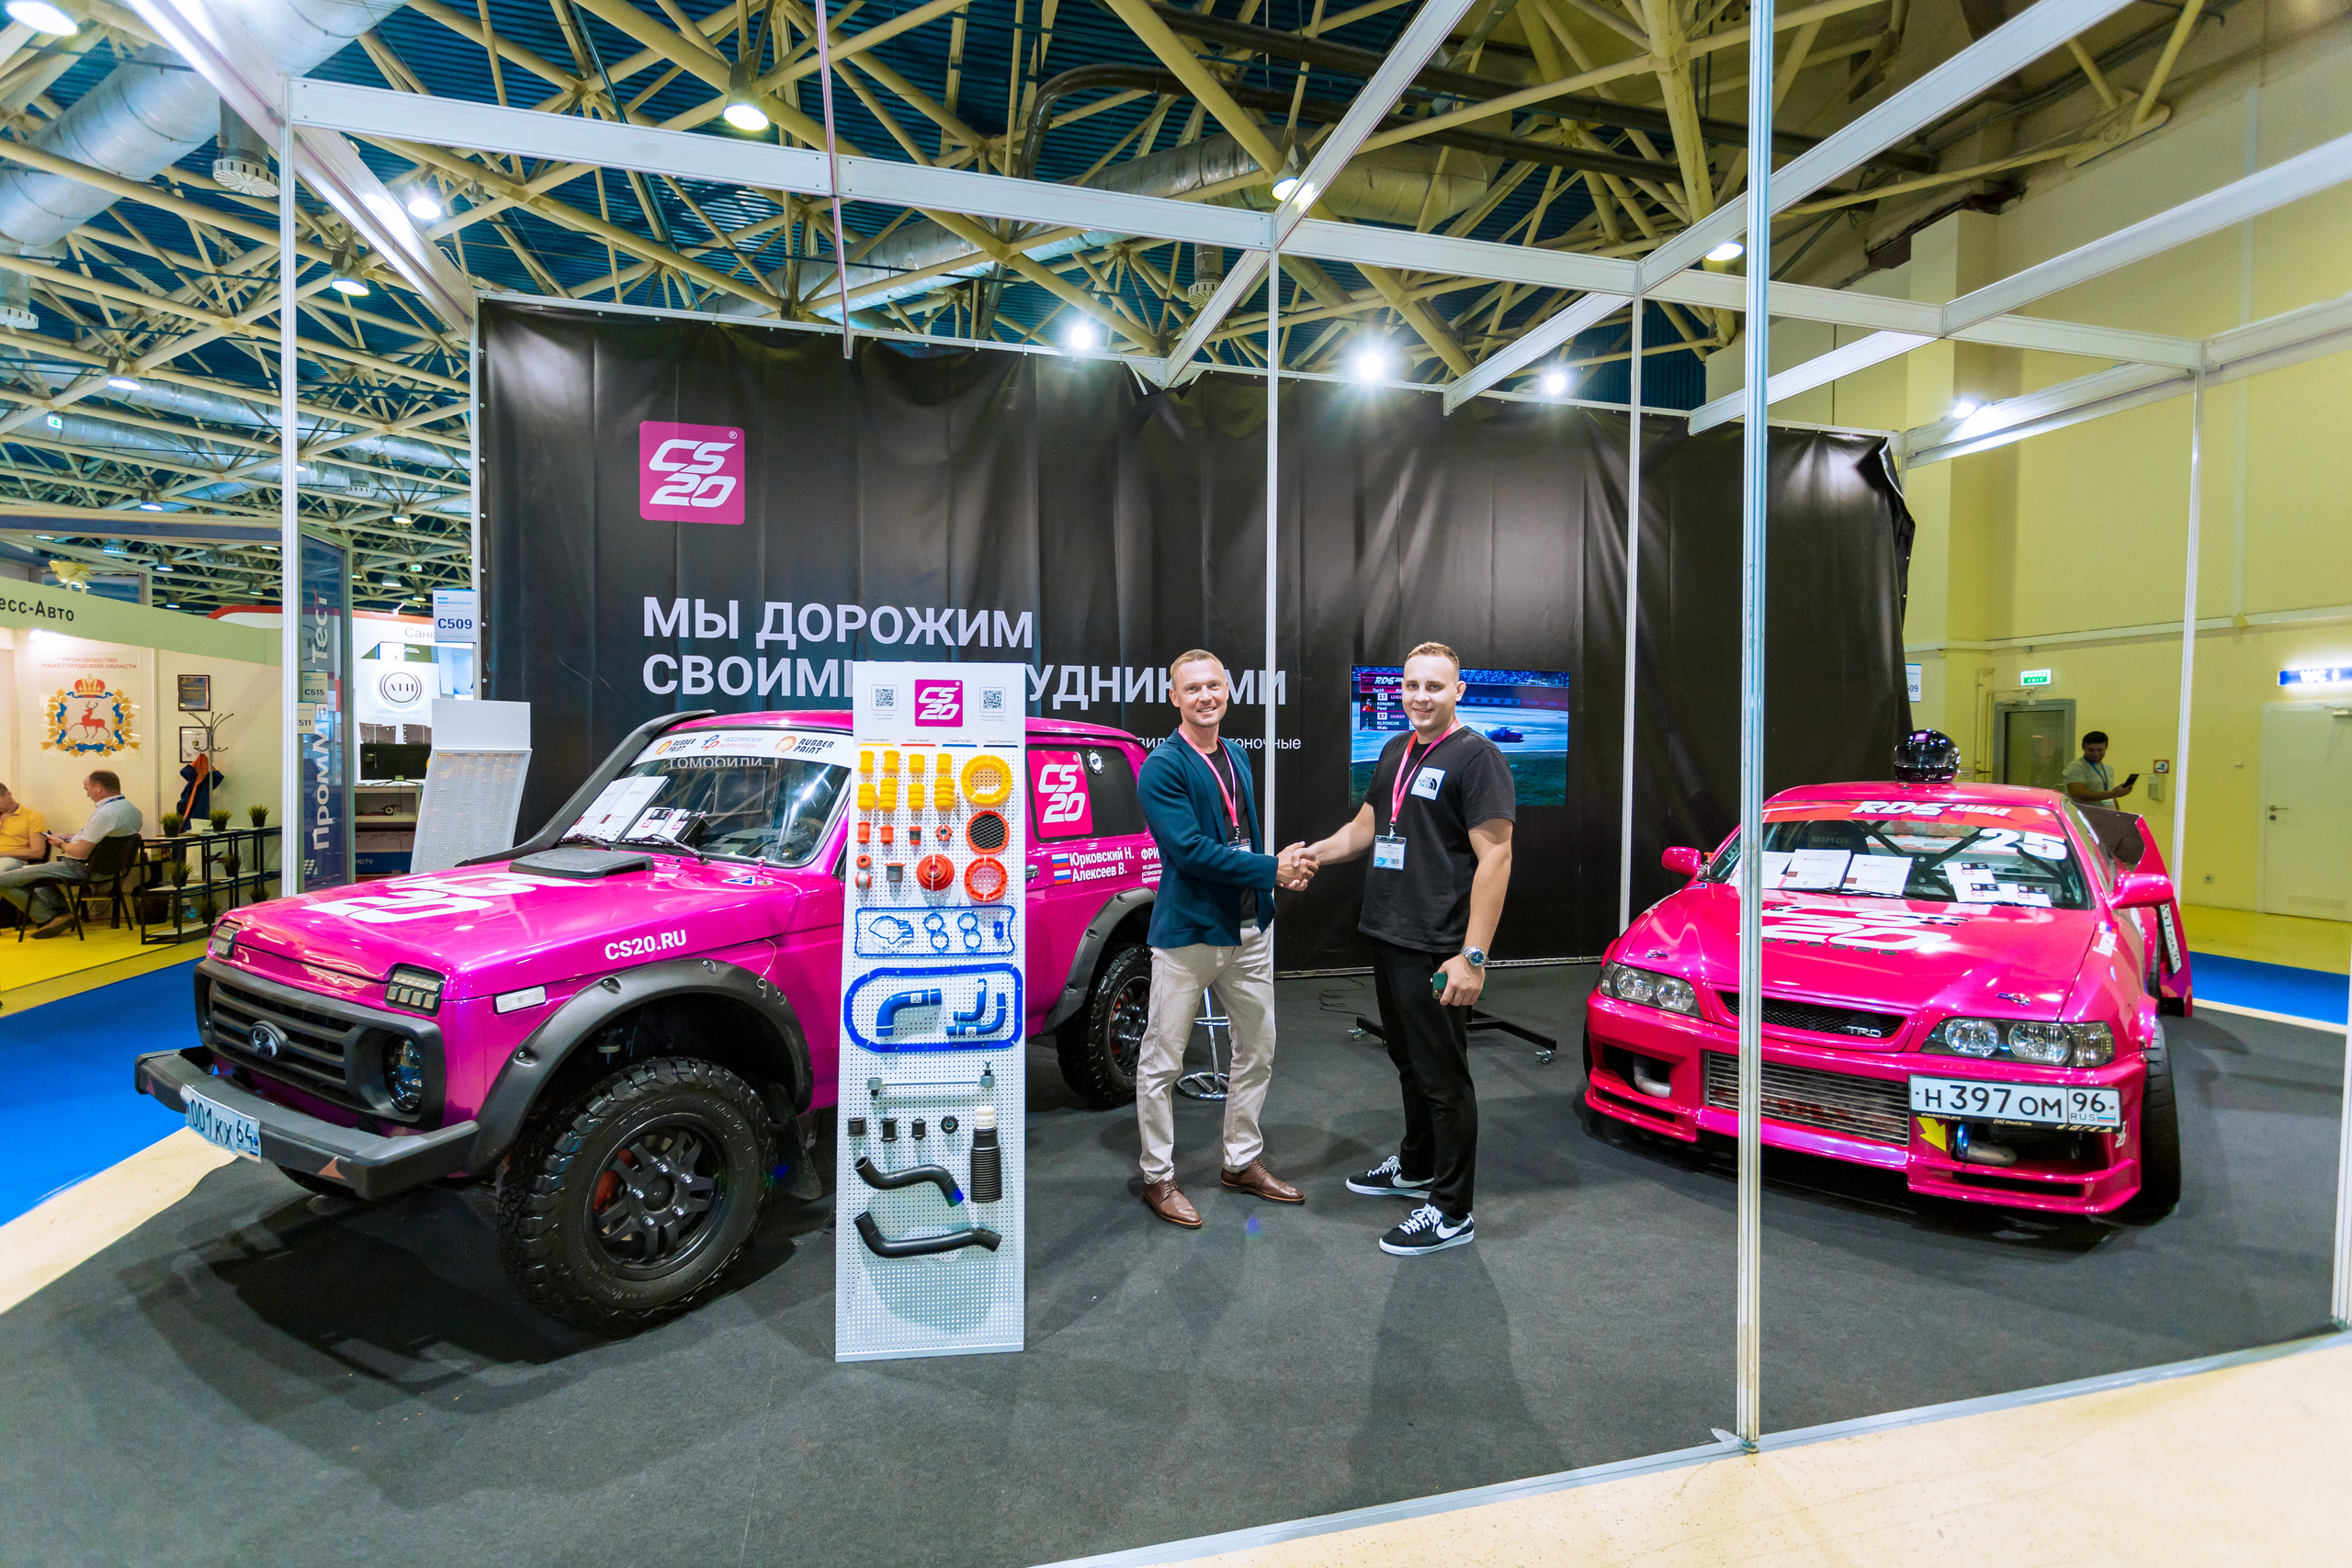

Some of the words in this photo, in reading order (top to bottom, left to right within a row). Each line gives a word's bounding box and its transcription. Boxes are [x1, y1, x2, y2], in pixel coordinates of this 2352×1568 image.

[649, 439, 736, 474] CS
[649, 472, 737, 508] 20
[437, 618, 472, 629] C509
[643, 596, 739, 639] МЫ
[755, 602, 1033, 650] ДОРОЖИМ
[1374, 676, 1396, 684] RDS
[2300, 669, 2328, 683] WC
[304, 688, 325, 696] C515
[918, 686, 960, 704] CS
[918, 704, 960, 720] 20
[793, 746, 823, 755] PAINT
[798, 738, 835, 749] RUBBER
[312, 670, 334, 850] ПромМа
[1038, 764, 1079, 793] CS
[1043, 793, 1086, 824] 20
[1851, 800, 1952, 817] RDS
[1811, 835, 1853, 844] BRIDE
[1979, 828, 2068, 861] 25
[1069, 847, 1124, 868] Юрковский
[1124, 846, 1135, 860] Н.
[1140, 847, 1161, 861] ФРИ
[1071, 866, 1117, 883] Алексеев
[1117, 862, 1128, 875] В.
[605, 929, 687, 961] CS20.RU
[1846, 1025, 1882, 1038] TRD
[2072, 1091, 2107, 1112] 96
[2070, 1112, 2096, 1122] RUS
[236, 1119, 254, 1147] 64
